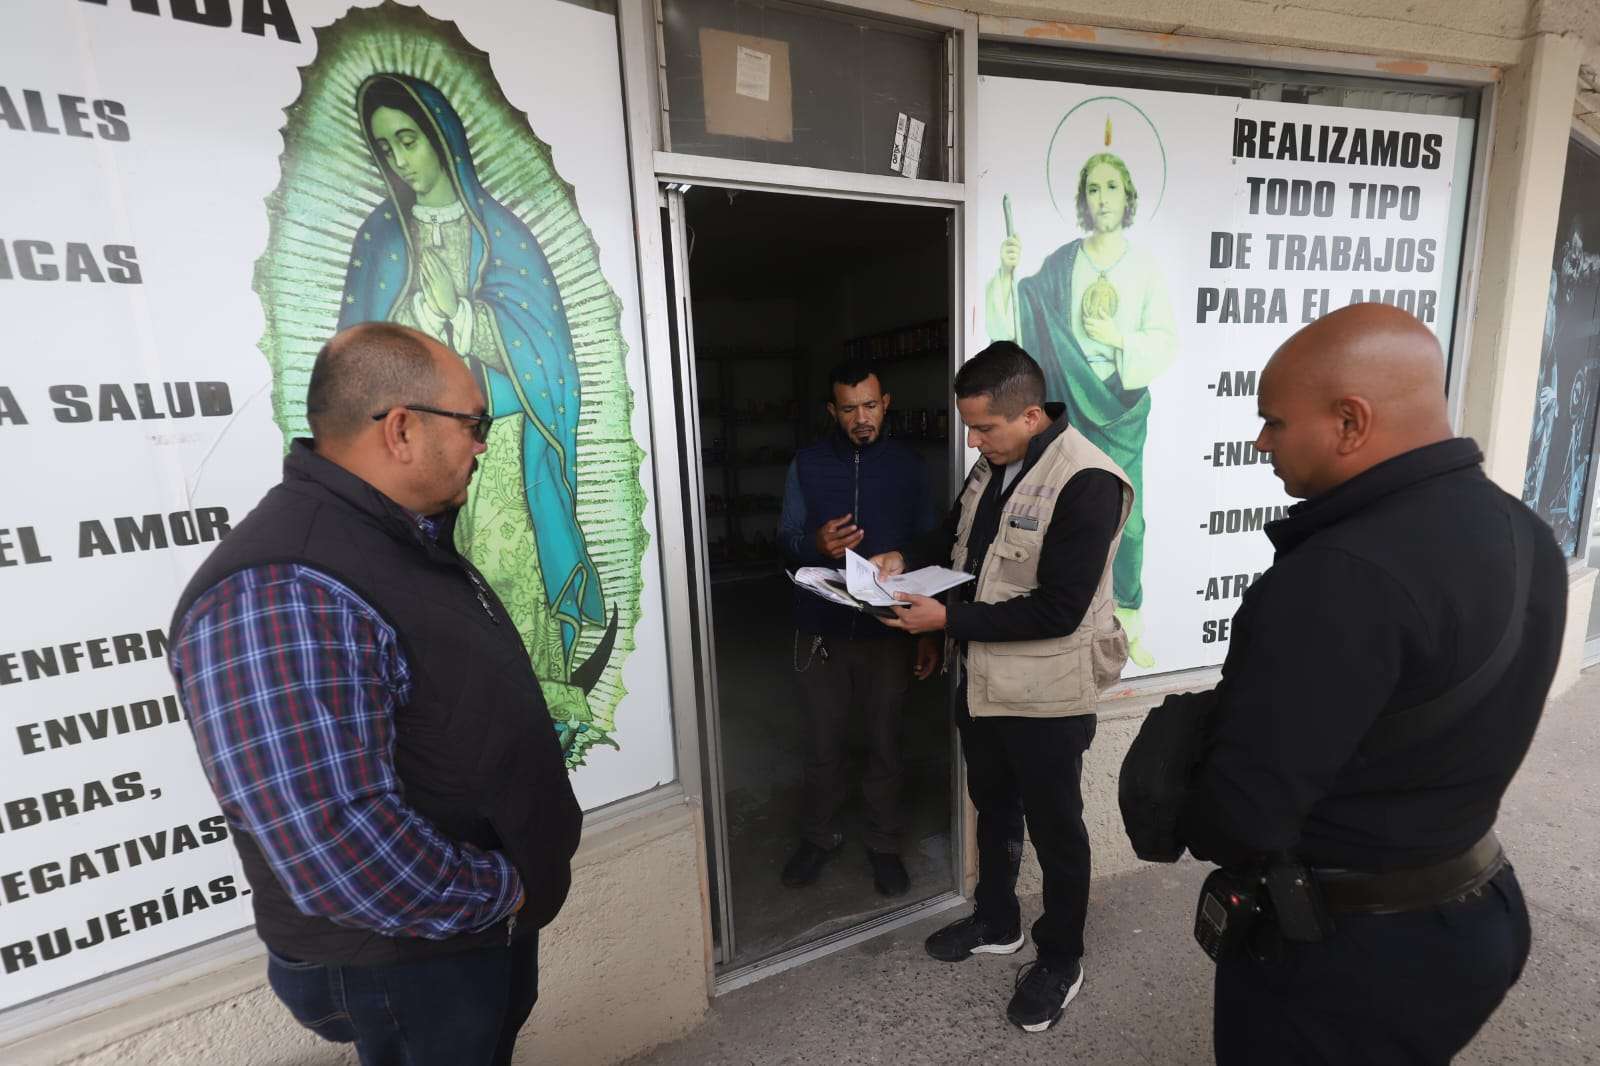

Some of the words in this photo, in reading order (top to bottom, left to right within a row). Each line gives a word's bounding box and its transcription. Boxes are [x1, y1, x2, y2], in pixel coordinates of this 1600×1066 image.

[1232, 118, 1443, 170] REALIZAMOS
[1246, 176, 1336, 218] TODO
[1349, 182, 1421, 221] TIPO
[1209, 231, 1252, 270] DE
[1266, 233, 1437, 273] TRABAJOS
[1196, 287, 1288, 324] PARA
[0, 386, 29, 426] A
[48, 381, 233, 423] SALUD
[1207, 370, 1260, 397] -AM
[78, 506, 232, 558] AMOR
[1202, 618, 1230, 644] SE
[16, 694, 188, 755] ENVIDI
[0, 771, 162, 834] BRAS,
